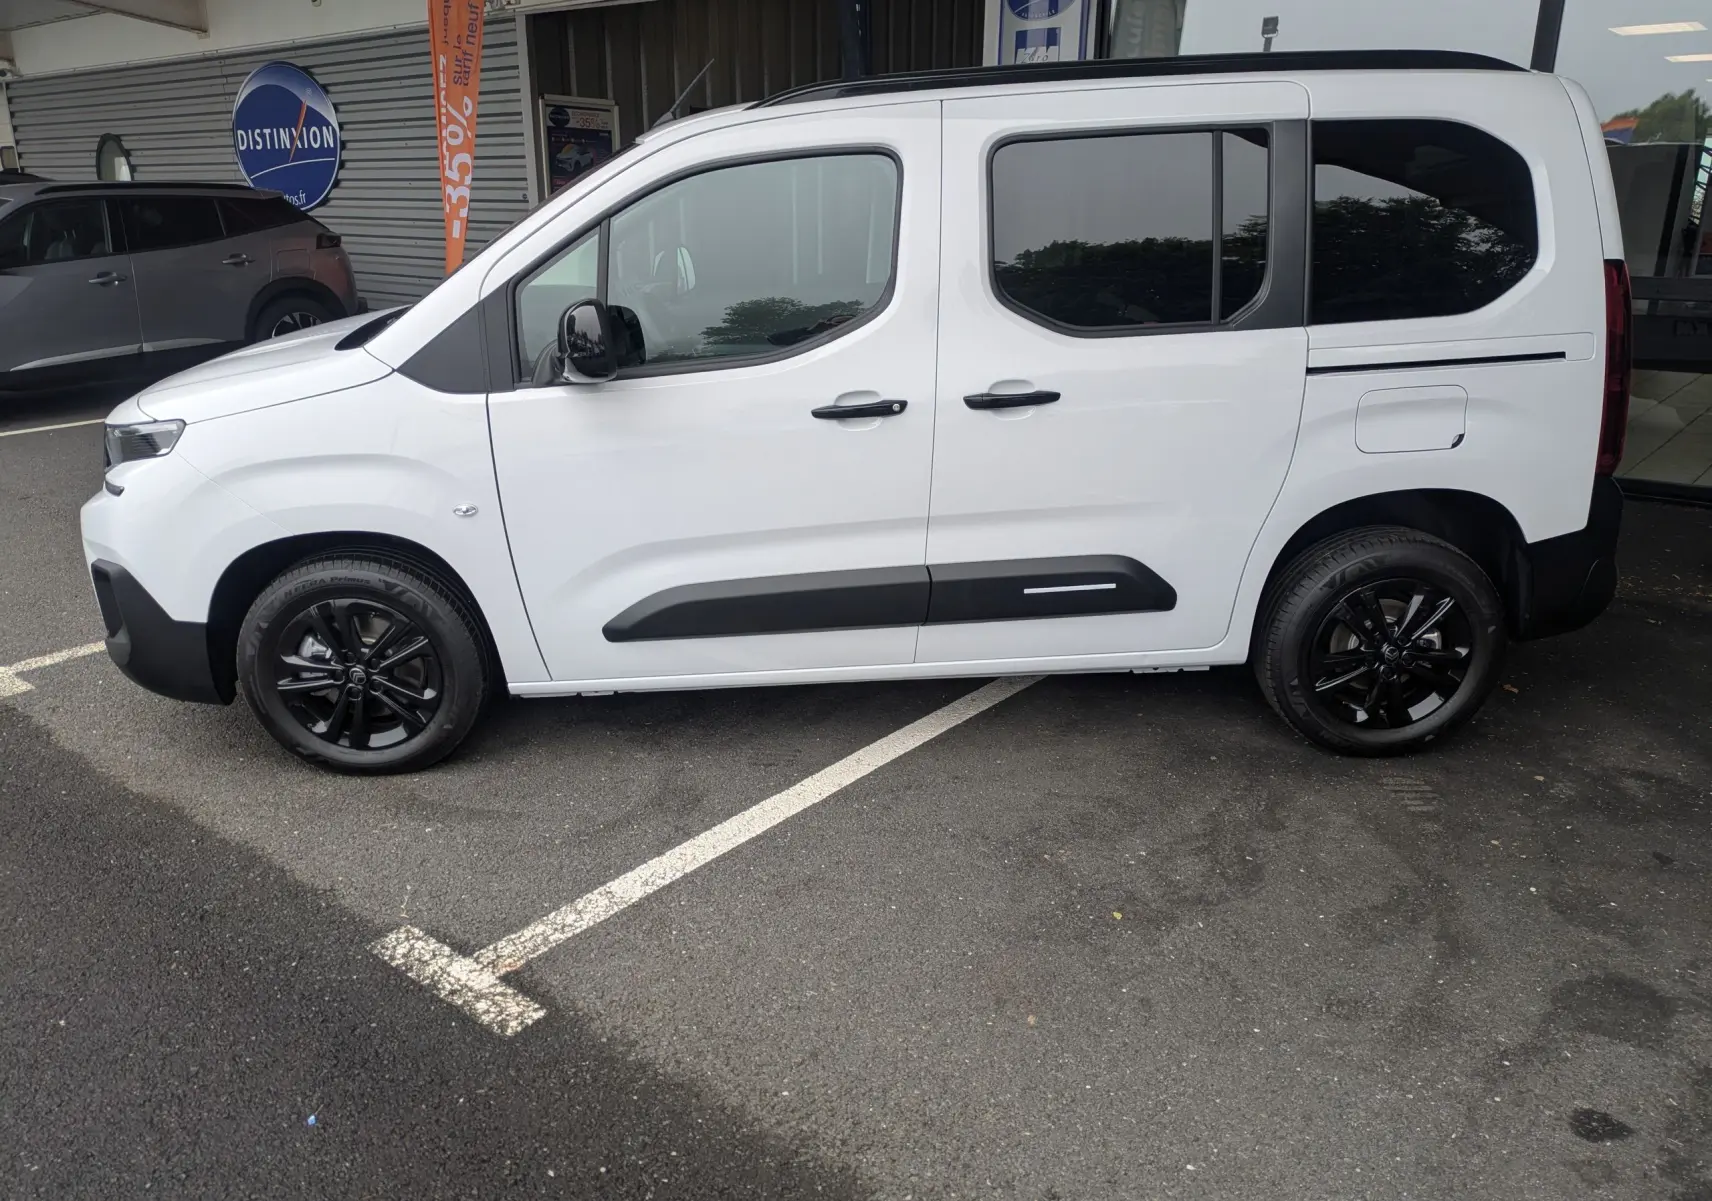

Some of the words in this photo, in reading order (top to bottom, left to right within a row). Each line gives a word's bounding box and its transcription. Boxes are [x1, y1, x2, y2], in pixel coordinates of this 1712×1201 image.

[466, 2, 480, 45] neuf
[453, 34, 462, 50] le
[453, 56, 463, 86] sur
[462, 48, 473, 86] tarif
[237, 125, 334, 151] DISTINXION
[445, 95, 473, 239] -35%
